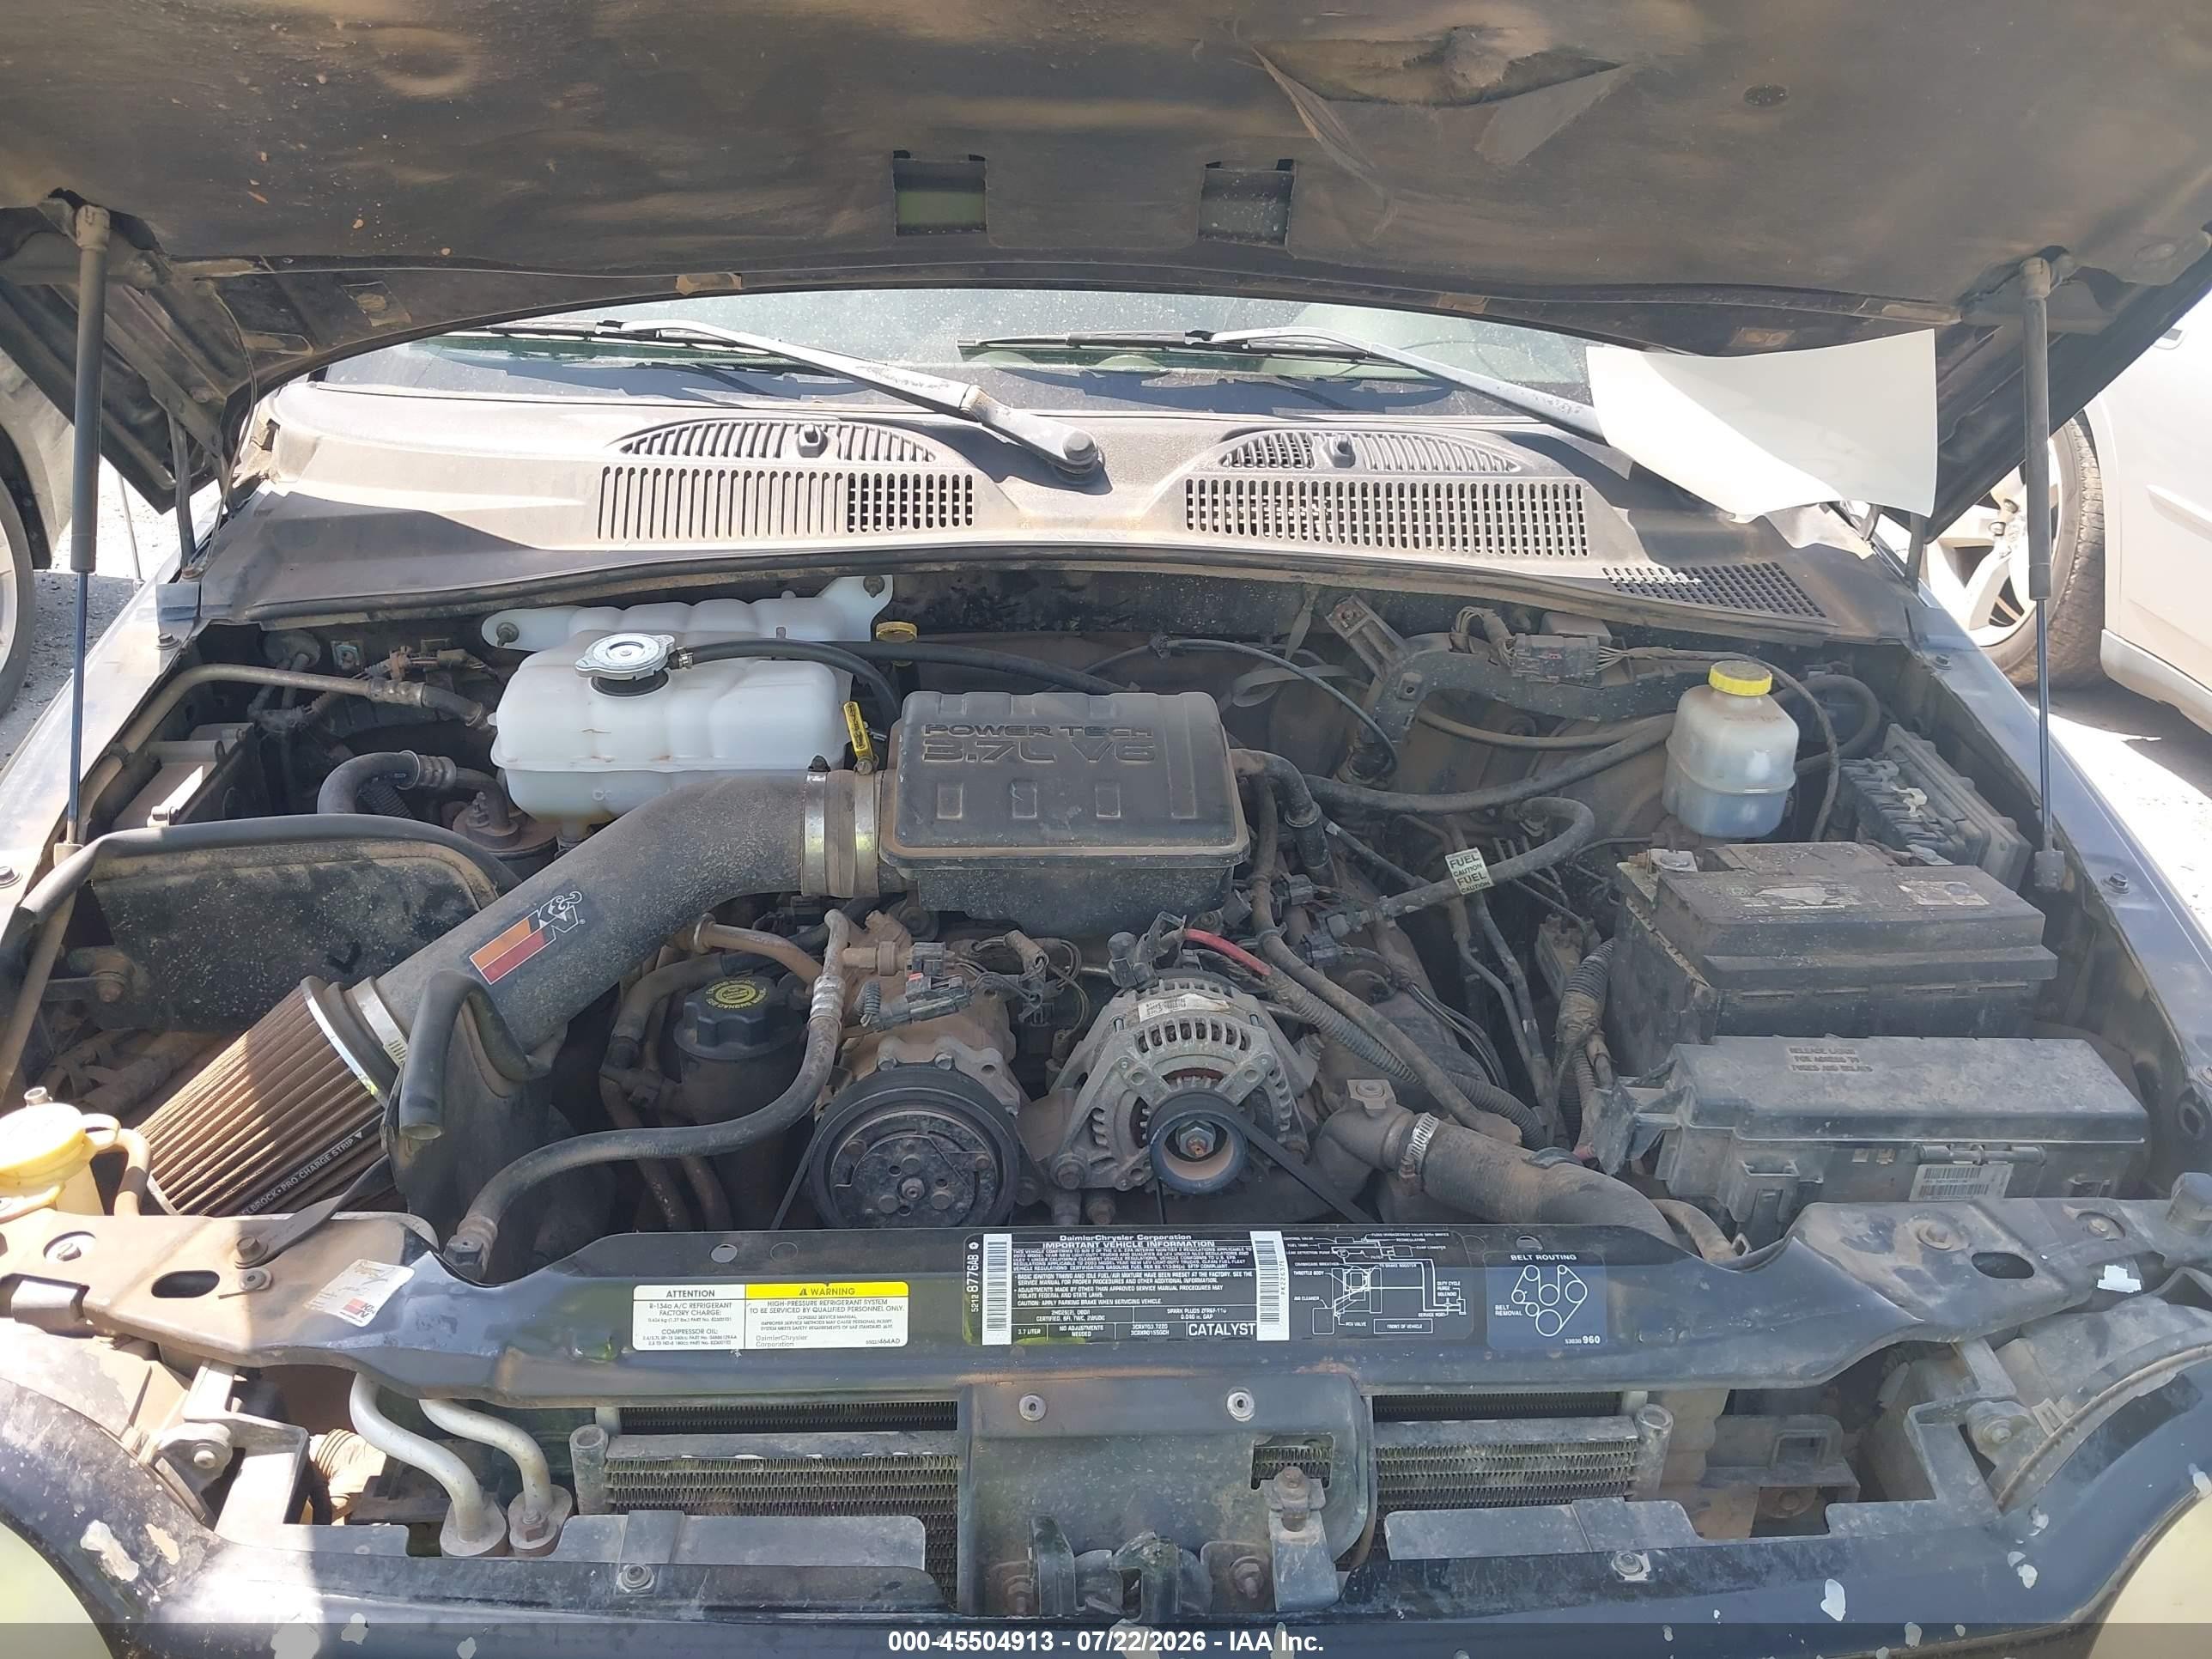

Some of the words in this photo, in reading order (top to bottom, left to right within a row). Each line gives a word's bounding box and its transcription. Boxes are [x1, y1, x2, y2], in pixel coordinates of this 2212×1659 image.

[923, 724, 1054, 738] POWER
[1060, 725, 1154, 738] TECH
[921, 740, 1055, 763] 3.7L
[1070, 740, 1155, 763] V6
[1449, 854, 1480, 869] FUEL
[1453, 863, 1482, 877] CAUTION
[1456, 872, 1486, 886] FUEL
[1462, 881, 1491, 893] CAUTION
[299, 1153, 331, 1179] CHARGE
[332, 1138, 355, 1157] STRIP
[1188, 1323, 1255, 1335] CATALYST
[1583, 1335, 1601, 1344] 960
